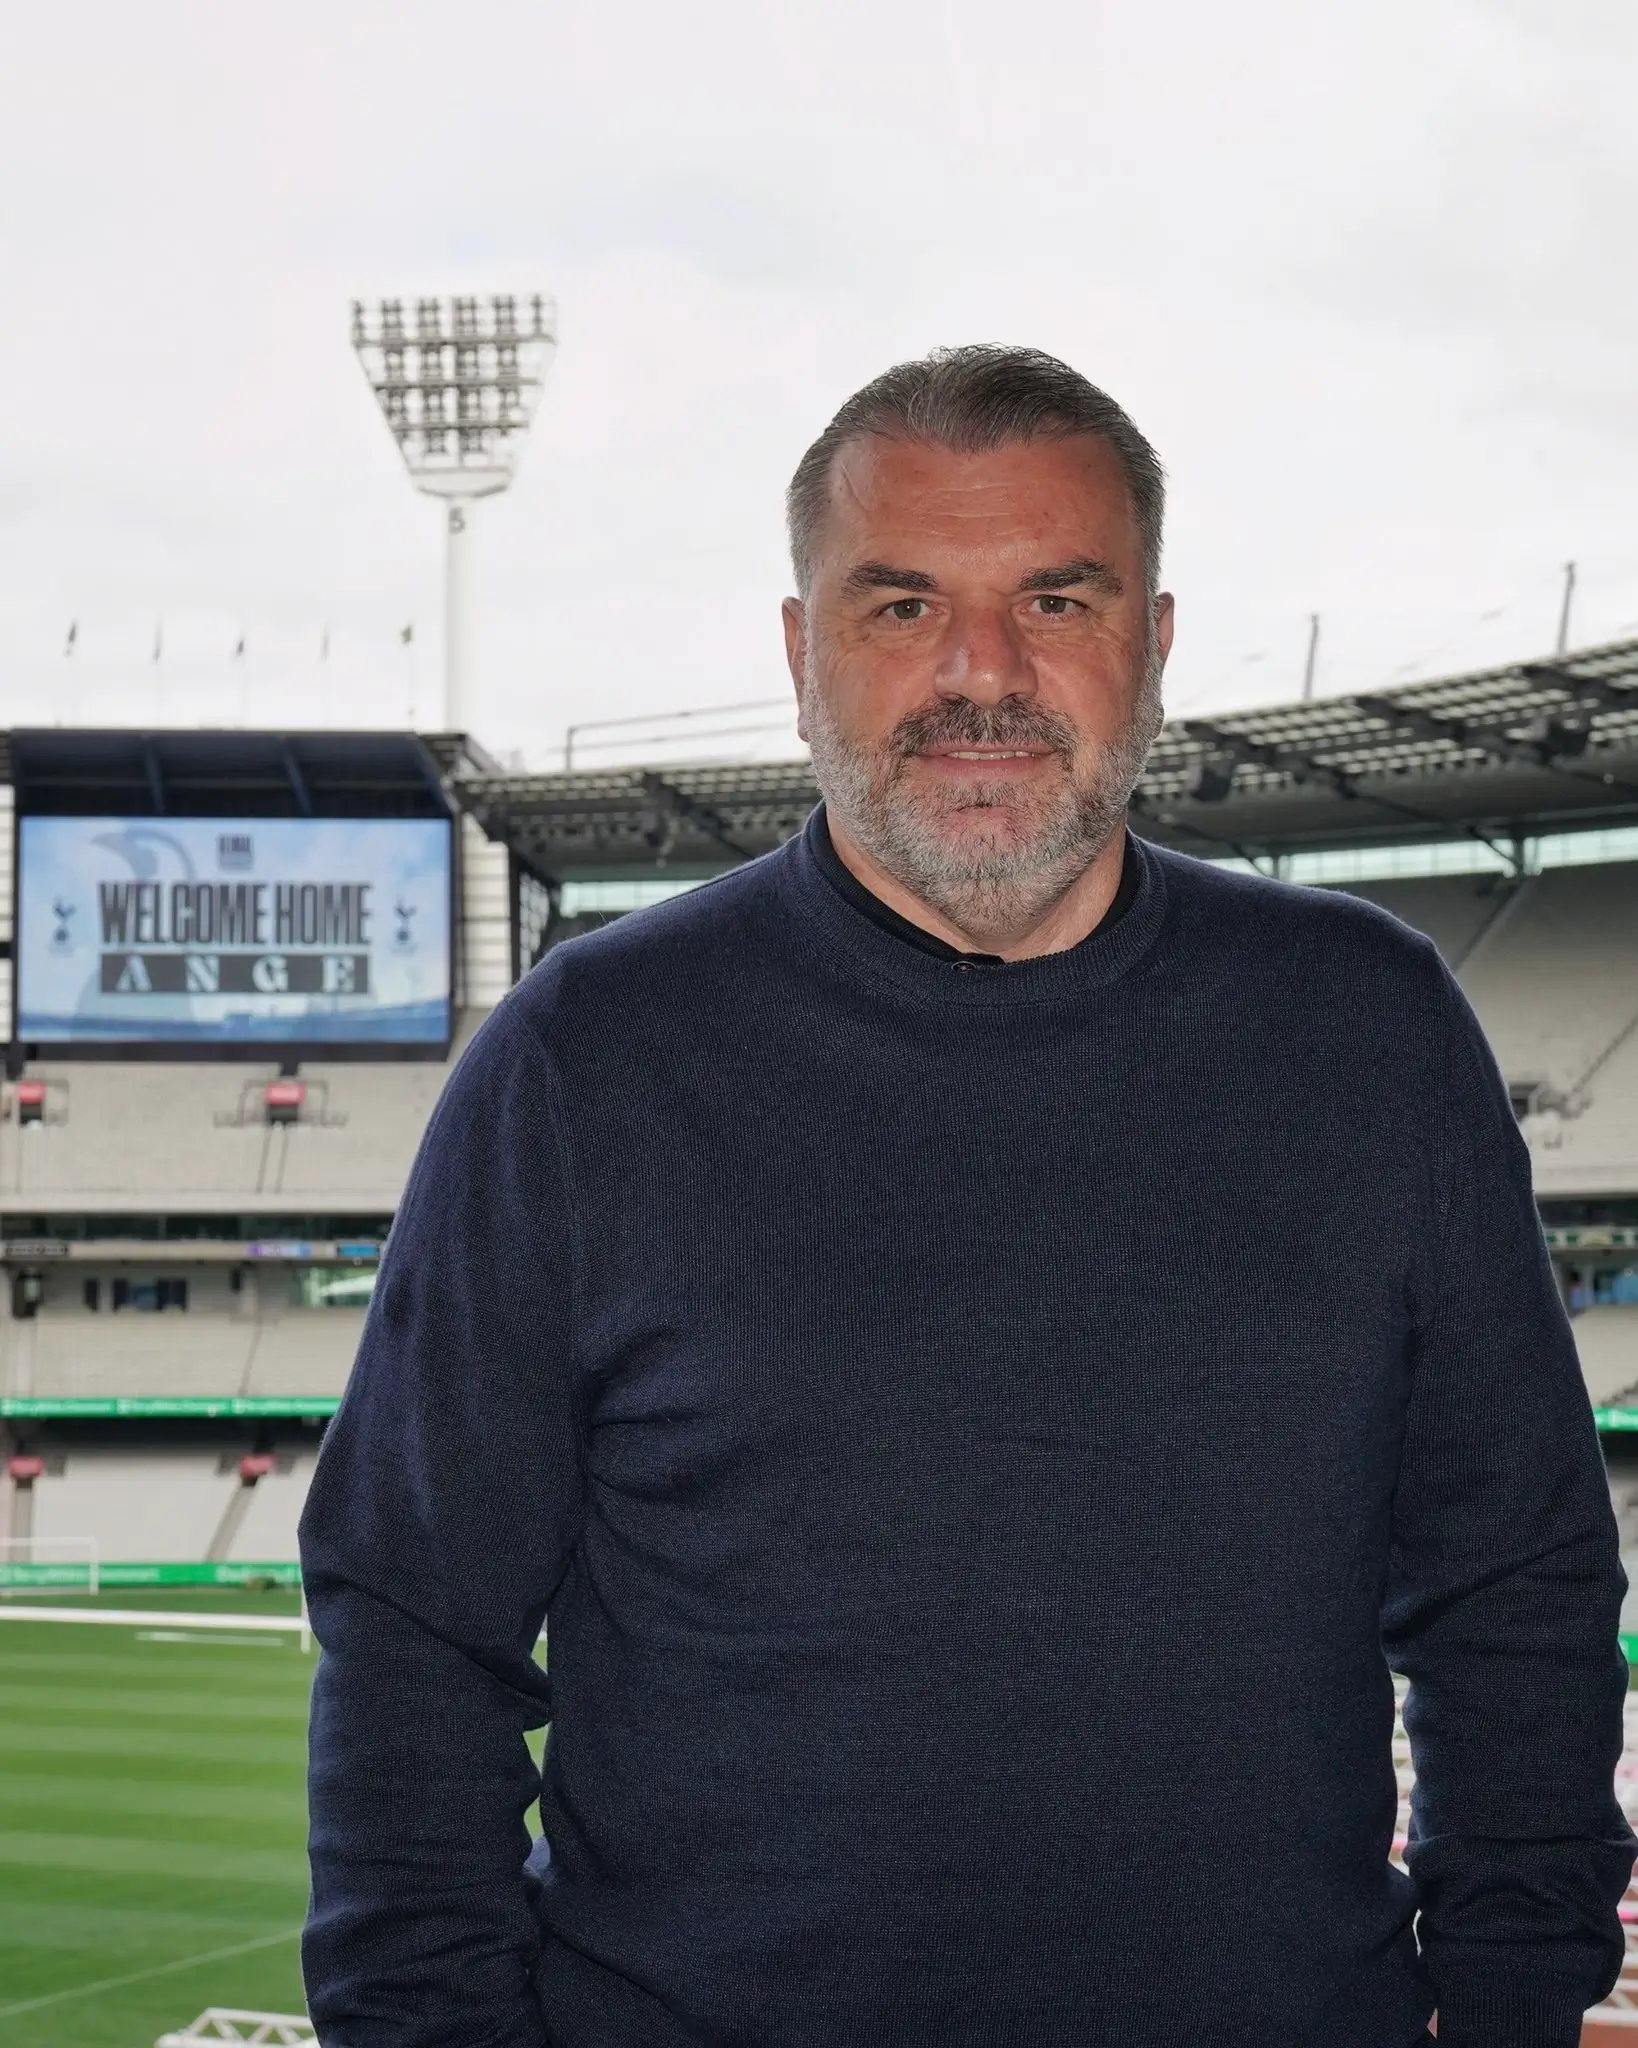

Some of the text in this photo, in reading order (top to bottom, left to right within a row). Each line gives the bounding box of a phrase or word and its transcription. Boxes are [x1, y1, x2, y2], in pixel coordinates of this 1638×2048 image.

[100, 882, 371, 944] WELCOME HOME
[115, 954, 356, 993] ANGE
